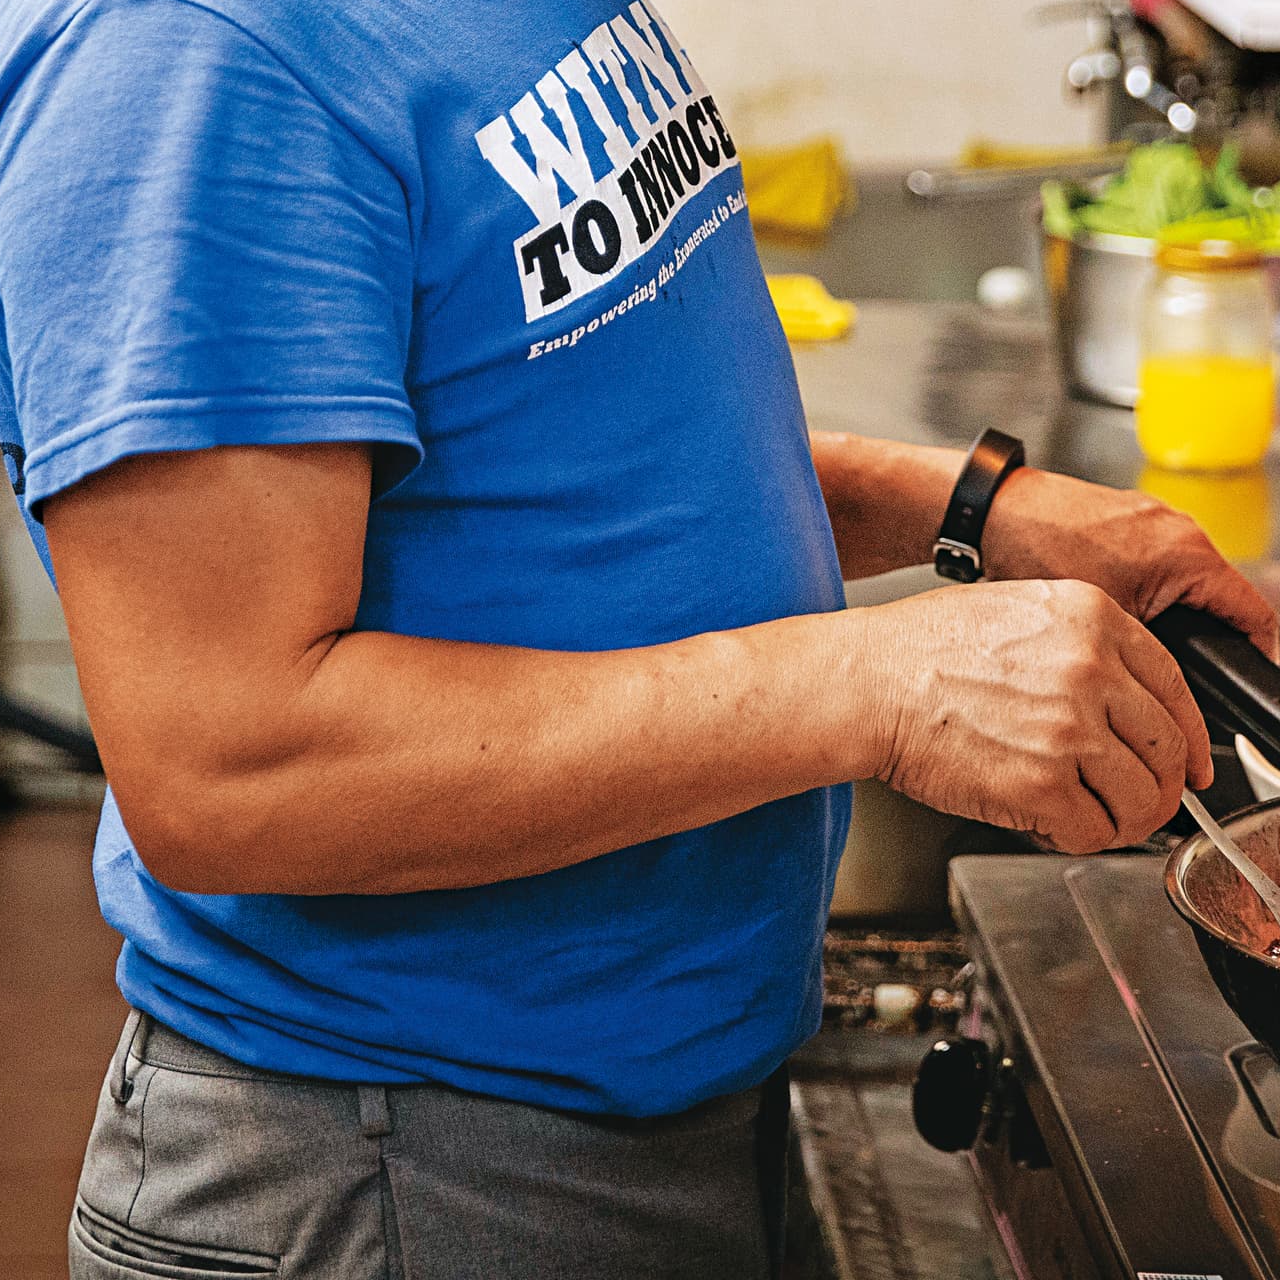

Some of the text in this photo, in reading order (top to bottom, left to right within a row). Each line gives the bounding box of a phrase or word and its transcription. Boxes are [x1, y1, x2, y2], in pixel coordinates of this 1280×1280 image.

[521, 199, 621, 307] TO
[527, 277, 656, 360] Empowering
[658, 261, 675, 288] the
[674, 208, 720, 272] Exonerated
[717, 205, 730, 222] to
